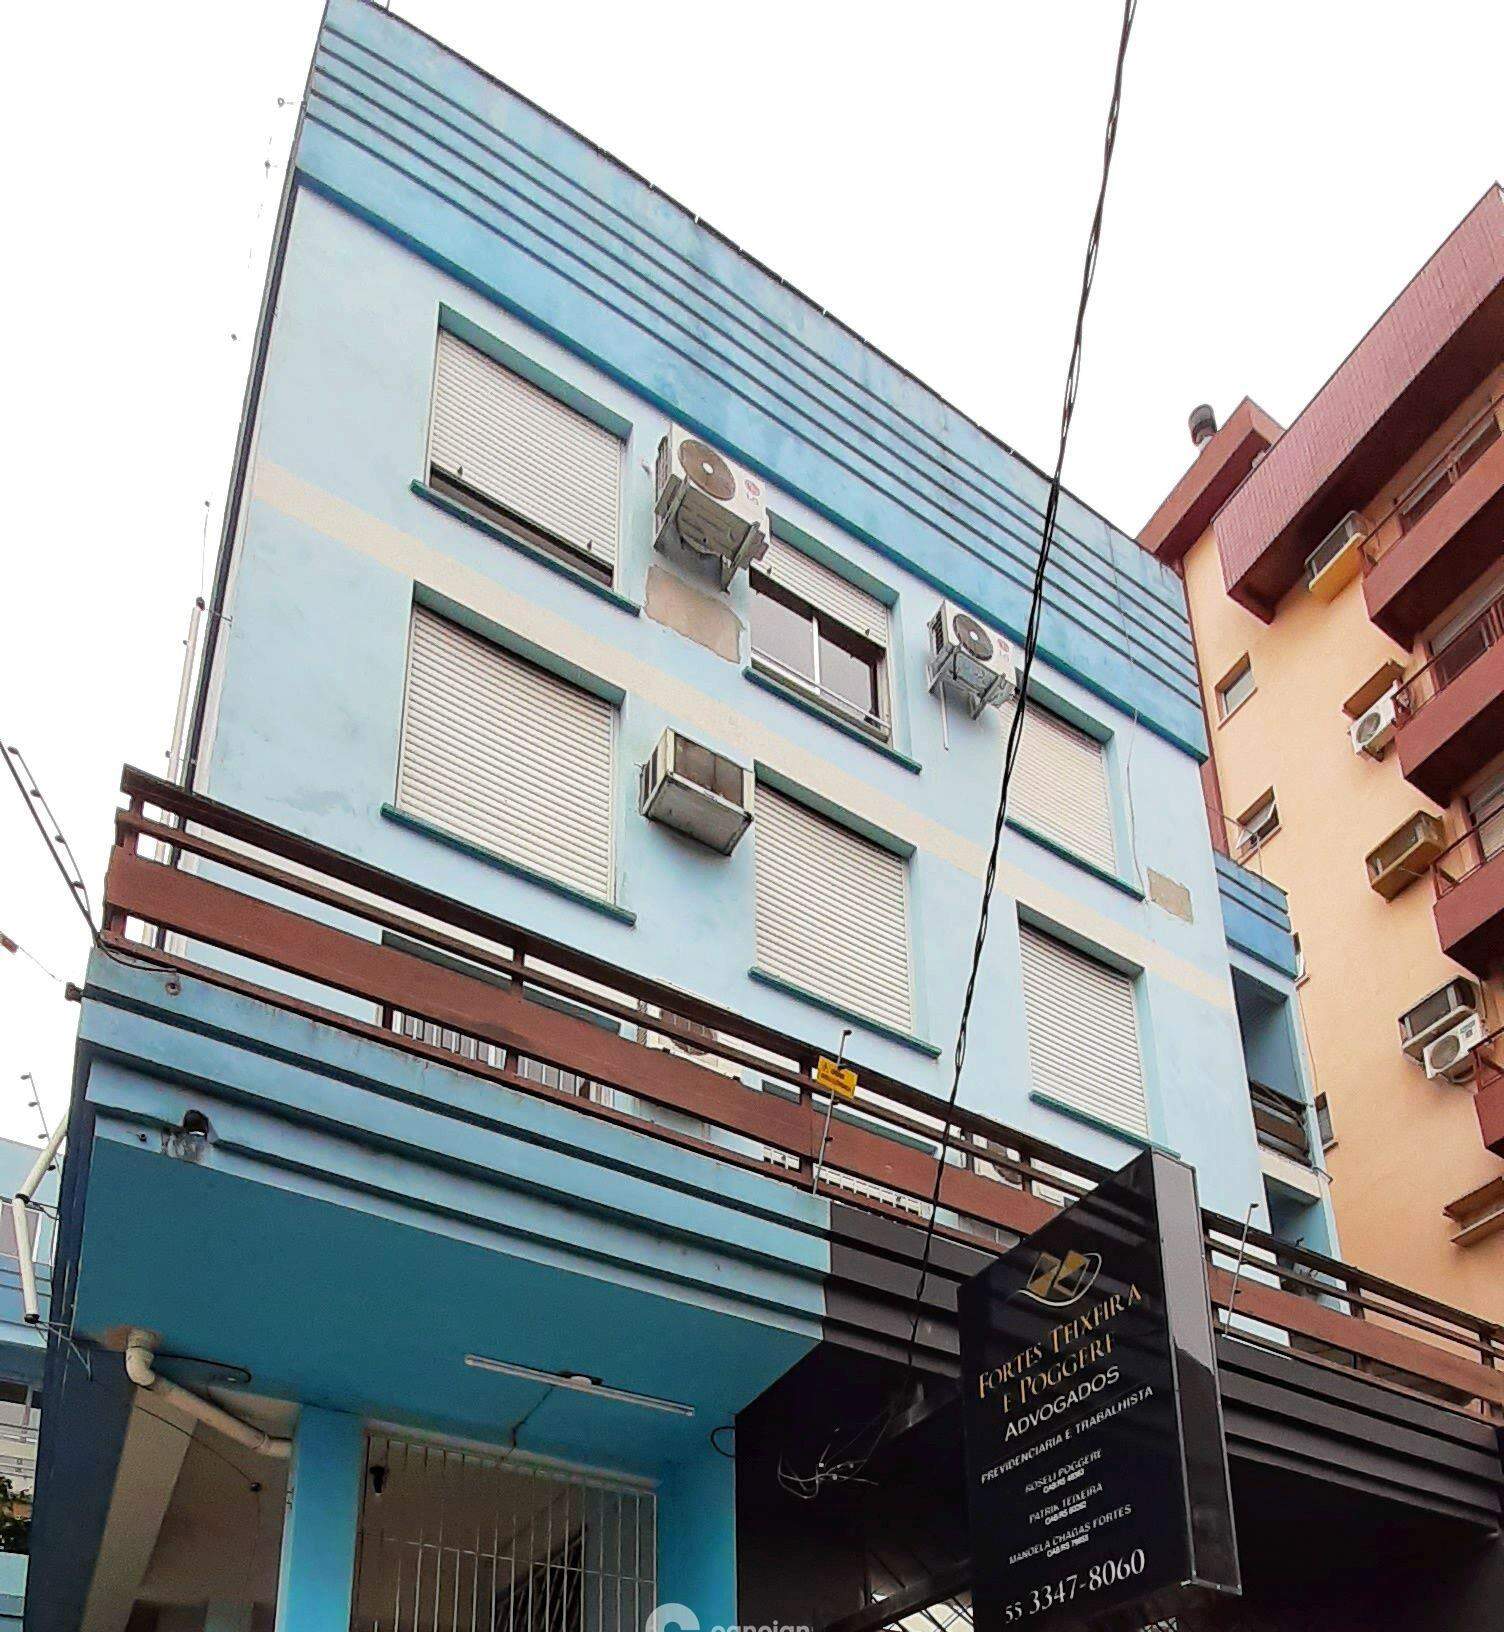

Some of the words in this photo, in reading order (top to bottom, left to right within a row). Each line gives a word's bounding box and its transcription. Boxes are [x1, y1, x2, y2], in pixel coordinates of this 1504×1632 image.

[979, 1342, 1043, 1399] FORTES
[1051, 1283, 1142, 1353] TEIXEIRA
[1003, 1391, 1012, 1414] E
[1004, 1365, 1120, 1442] ADVOGADOS
[1065, 1428, 1072, 1440] E
[1075, 1386, 1154, 1434] TRABALHISTA
[1092, 1504, 1132, 1528] FORTES
[1005, 1601, 1023, 1623] 55
[1029, 1548, 1145, 1615] 3347-8060
